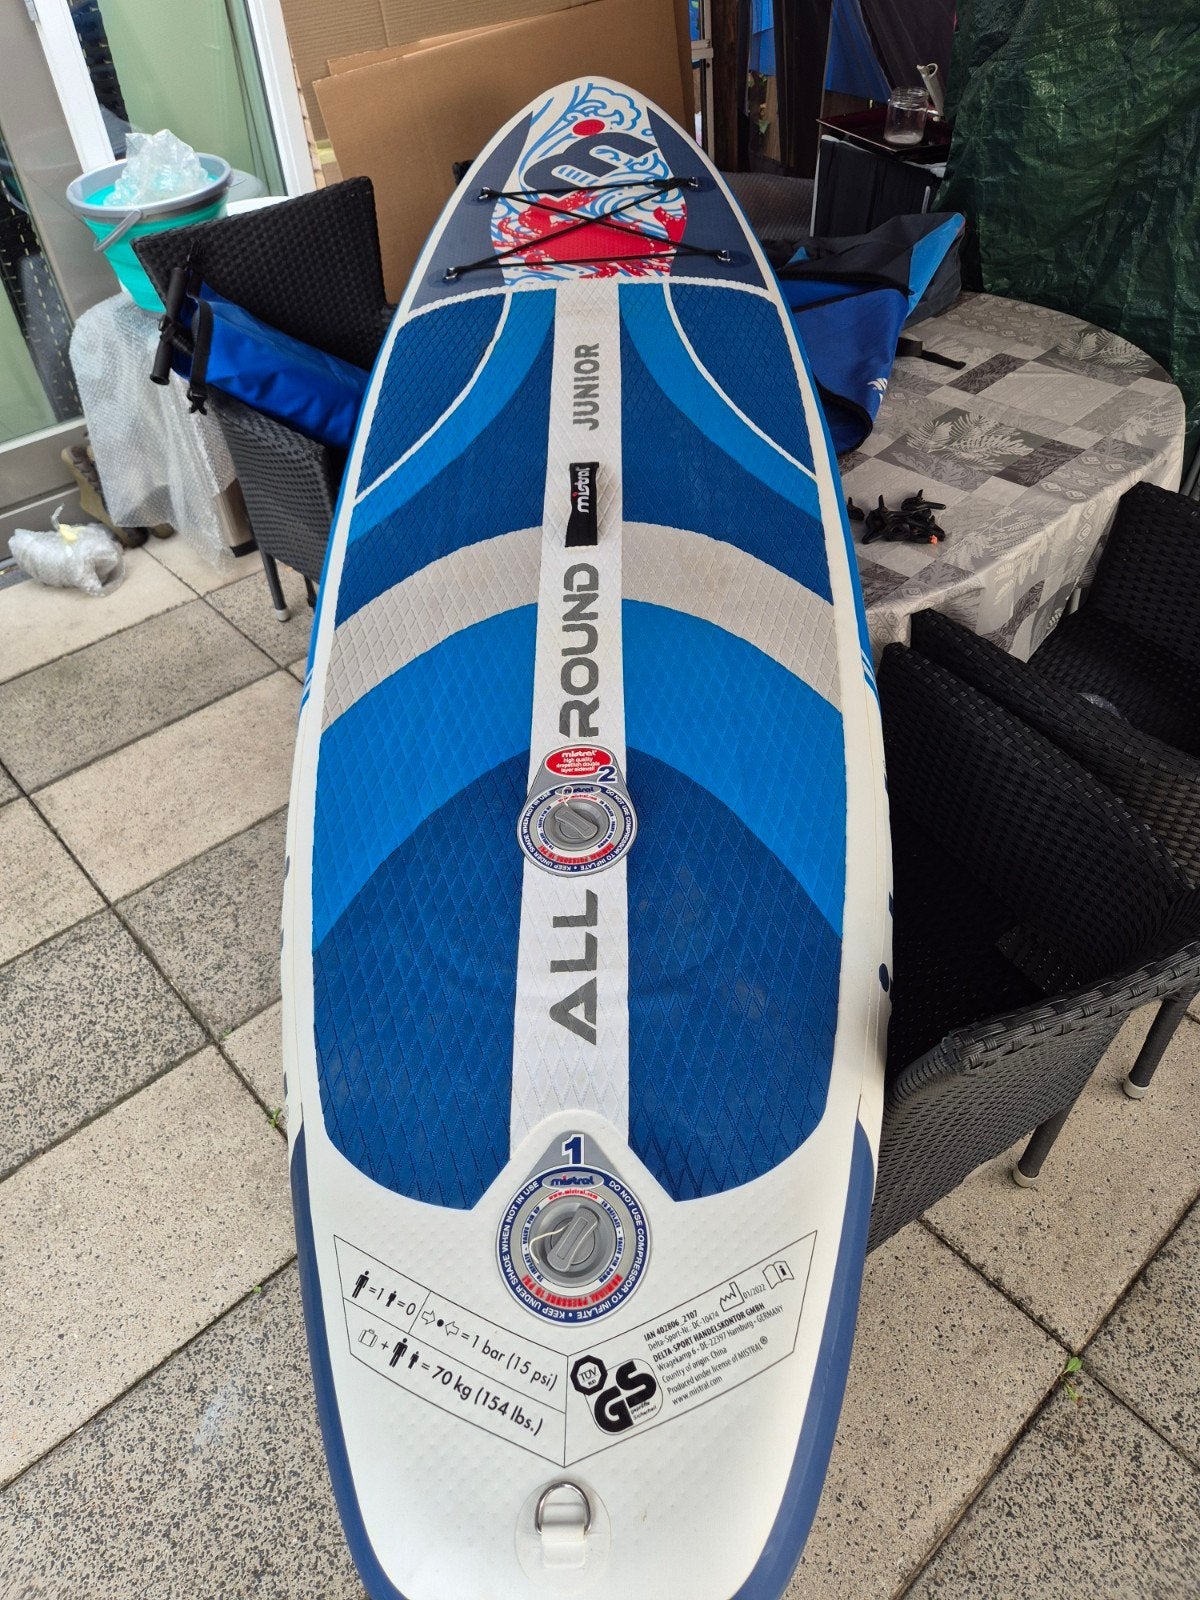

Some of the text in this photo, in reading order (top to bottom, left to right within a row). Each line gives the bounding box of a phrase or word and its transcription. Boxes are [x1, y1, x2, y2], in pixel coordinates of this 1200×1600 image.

[572, 343, 600, 431] JUNIOR
[572, 466, 591, 514] mistral
[559, 563, 599, 738] ROUND
[598, 765, 617, 782] 2
[549, 889, 598, 1045] ALL
[563, 1134, 583, 1165] 1
[551, 1174, 594, 1185] mistral
[501, 1180, 565, 1319] KEEP UNDER SHADE WHEN NOT IN USE
[576, 1180, 645, 1319] DO NOT USE COMPRESSOR TO INFLATE
[643, 1329, 656, 1341] IAN
[652, 1301, 766, 1362] DELTA-SPORT HANDELSKONTOR GMBH
[656, 1304, 784, 1371] Wragekamp 6 DE-22397 Hamburg GERMANY
[481, 1338, 506, 1362] bar
[505, 1352, 530, 1376] (15
[530, 1365, 559, 1392] psi)
[661, 1367, 686, 1384] Country
[685, 1362, 692, 1373] of
[709, 1347, 728, 1360] China
[666, 1375, 695, 1395] Produced
[694, 1368, 712, 1382] under
[711, 1359, 732, 1374] license
[731, 1353, 739, 1363] of
[672, 1375, 723, 1405] www.mistral.com
[431, 1365, 453, 1386] 70
[453, 1375, 472, 1401] kg
[473, 1386, 509, 1416] (154
[509, 1403, 544, 1436] lbs.)
[594, 1360, 657, 1432] GS
